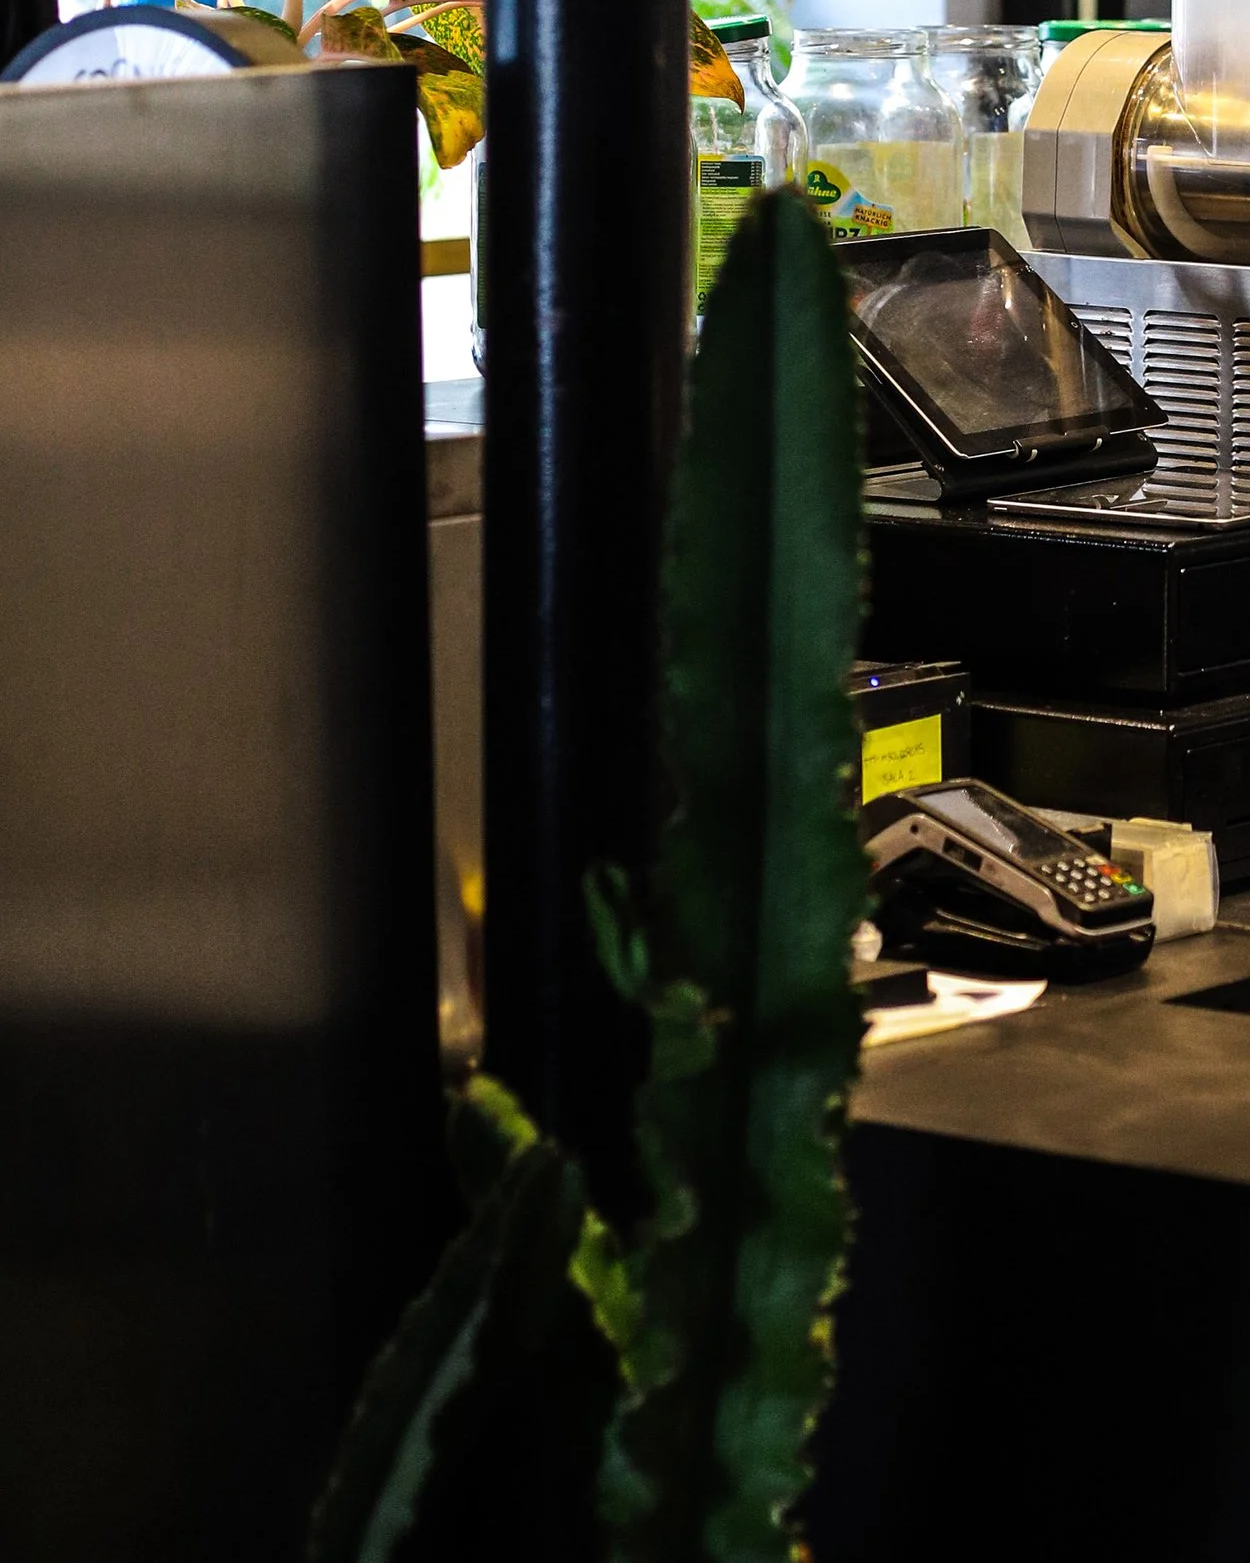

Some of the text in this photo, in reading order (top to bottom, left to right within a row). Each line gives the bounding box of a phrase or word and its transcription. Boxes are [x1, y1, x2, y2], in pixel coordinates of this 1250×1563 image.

[807, 186, 837, 198] ühne
[855, 206, 892, 221] NATÜRLICH
[855, 214, 888, 227] KNACKIG
